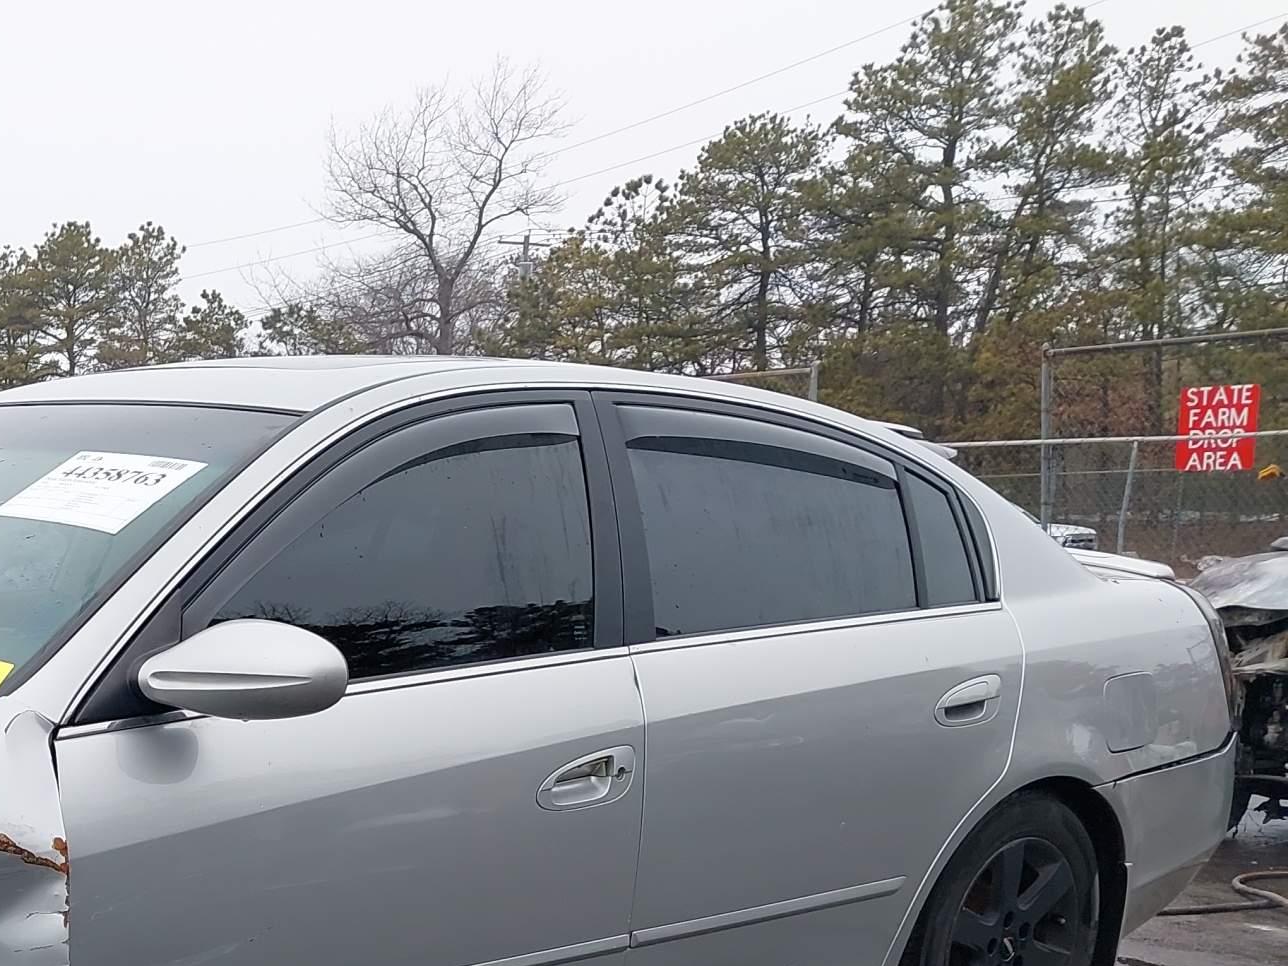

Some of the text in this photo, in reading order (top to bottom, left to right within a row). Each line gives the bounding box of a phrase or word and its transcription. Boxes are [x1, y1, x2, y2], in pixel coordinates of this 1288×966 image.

[1186, 384, 1254, 407] STATE
[1188, 406, 1249, 428] FARM
[1188, 428, 1245, 449] DROP
[1184, 451, 1242, 471] AREA
[62, 465, 167, 487] 44358763
